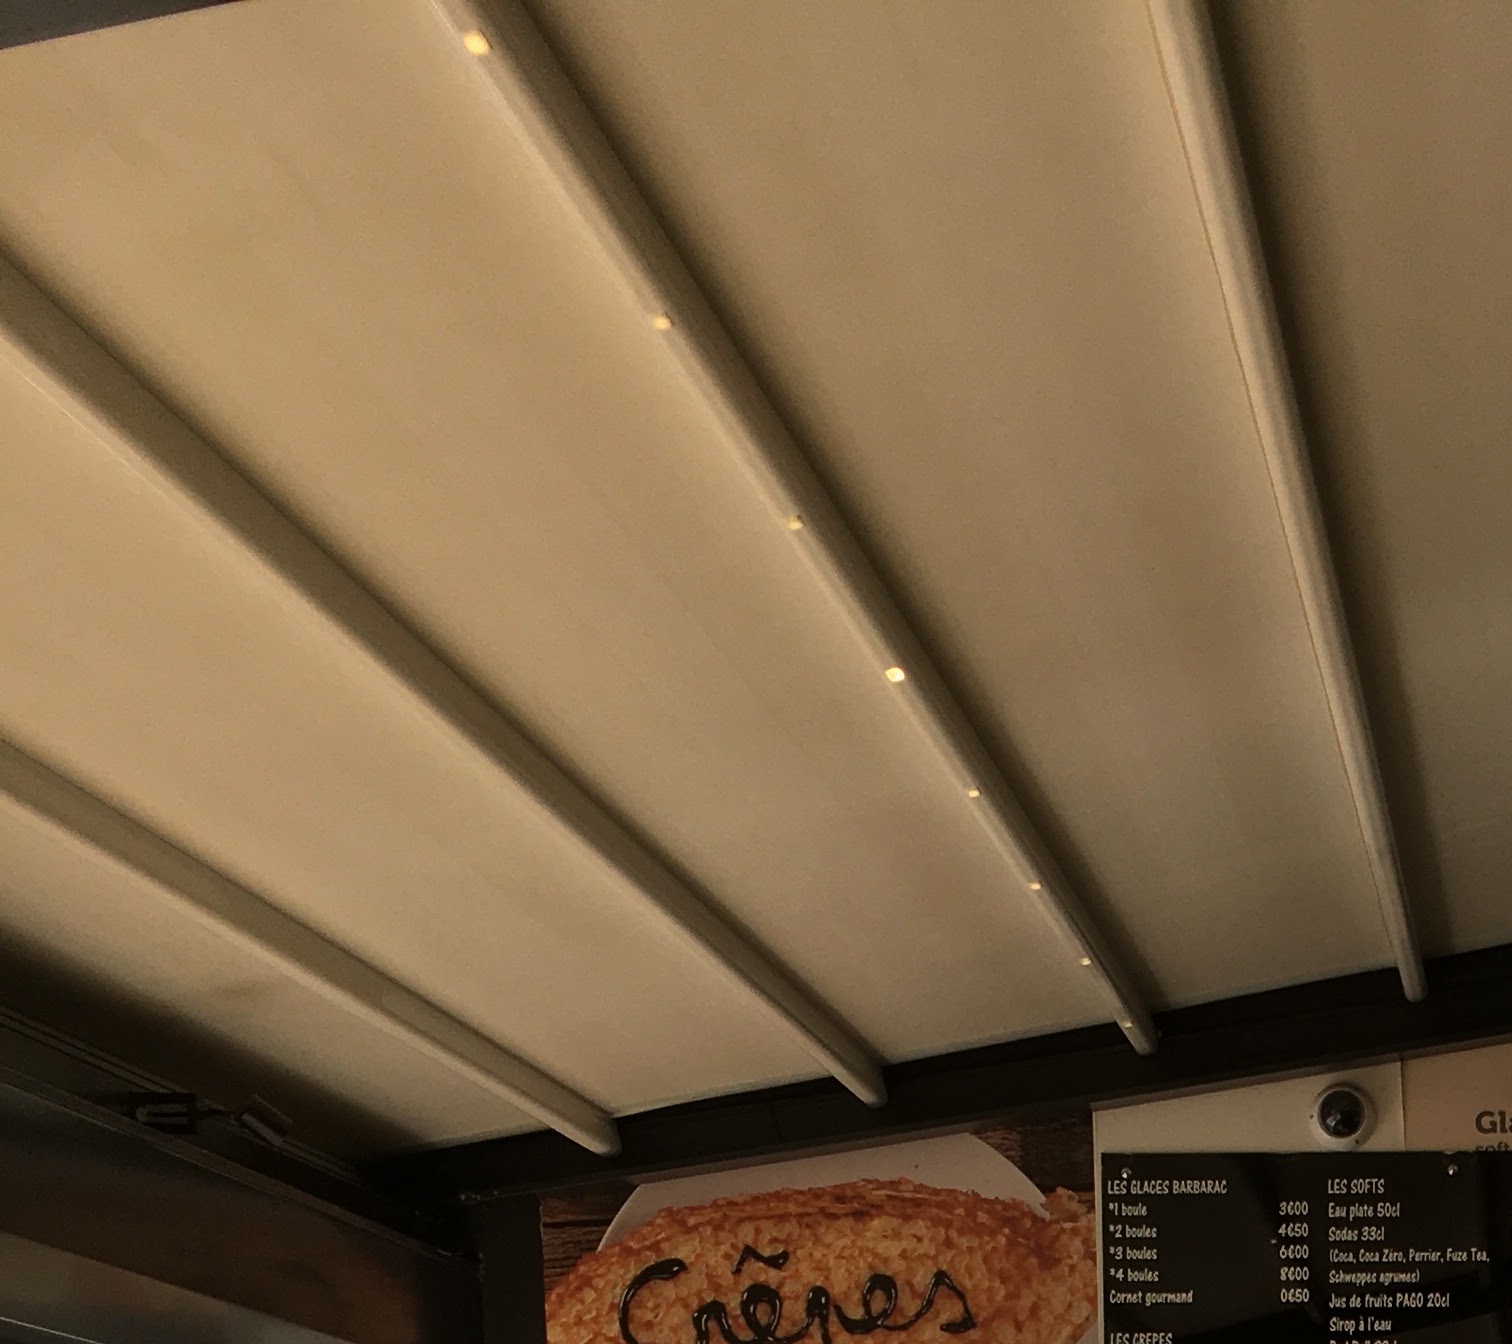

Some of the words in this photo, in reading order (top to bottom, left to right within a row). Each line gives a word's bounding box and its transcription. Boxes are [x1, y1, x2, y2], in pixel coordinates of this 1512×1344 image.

[1108, 1180, 1127, 1194] LES
[1131, 1180, 1169, 1194] GLACES
[1173, 1180, 1227, 1194] BARBARAC
[1328, 1179, 1347, 1193] LES
[1351, 1179, 1384, 1193] SOFTS
[1122, 1203, 1147, 1216] boule
[1279, 1201, 1308, 1215] 3€00
[1329, 1203, 1346, 1217] Eau
[1350, 1203, 1374, 1221] plate
[1377, 1203, 1400, 1217] 50cl
[1126, 1225, 1157, 1237] boules
[1278, 1223, 1308, 1237] 4€50
[1329, 1227, 1358, 1241] Sodas
[1361, 1227, 1384, 1240] 33cl
[1126, 1247, 1157, 1259] boules
[1280, 1245, 1308, 1259] 6€00
[1359, 1249, 1379, 1262] Coca
[1447, 1248, 1467, 1261] Fuze
[1128, 1268, 1158, 1281] boules
[1280, 1267, 1309, 1281] 8€00
[1329, 1270, 1376, 1286] Schweppes
[1110, 1290, 1142, 1303] Cornet
[1146, 1290, 1193, 1306] gourmand
[1281, 1289, 1309, 1302] 0€50
[1329, 1293, 1346, 1308] Jus
[1349, 1294, 1361, 1307] de
[1365, 1294, 1393, 1307] fruits
[1396, 1293, 1423, 1307] PAGO
[1427, 1293, 1449, 1307] 20cl
[1330, 1317, 1355, 1335] Sirop
[1359, 1317, 1364, 1331] à
[1368, 1317, 1391, 1331] l'eau
